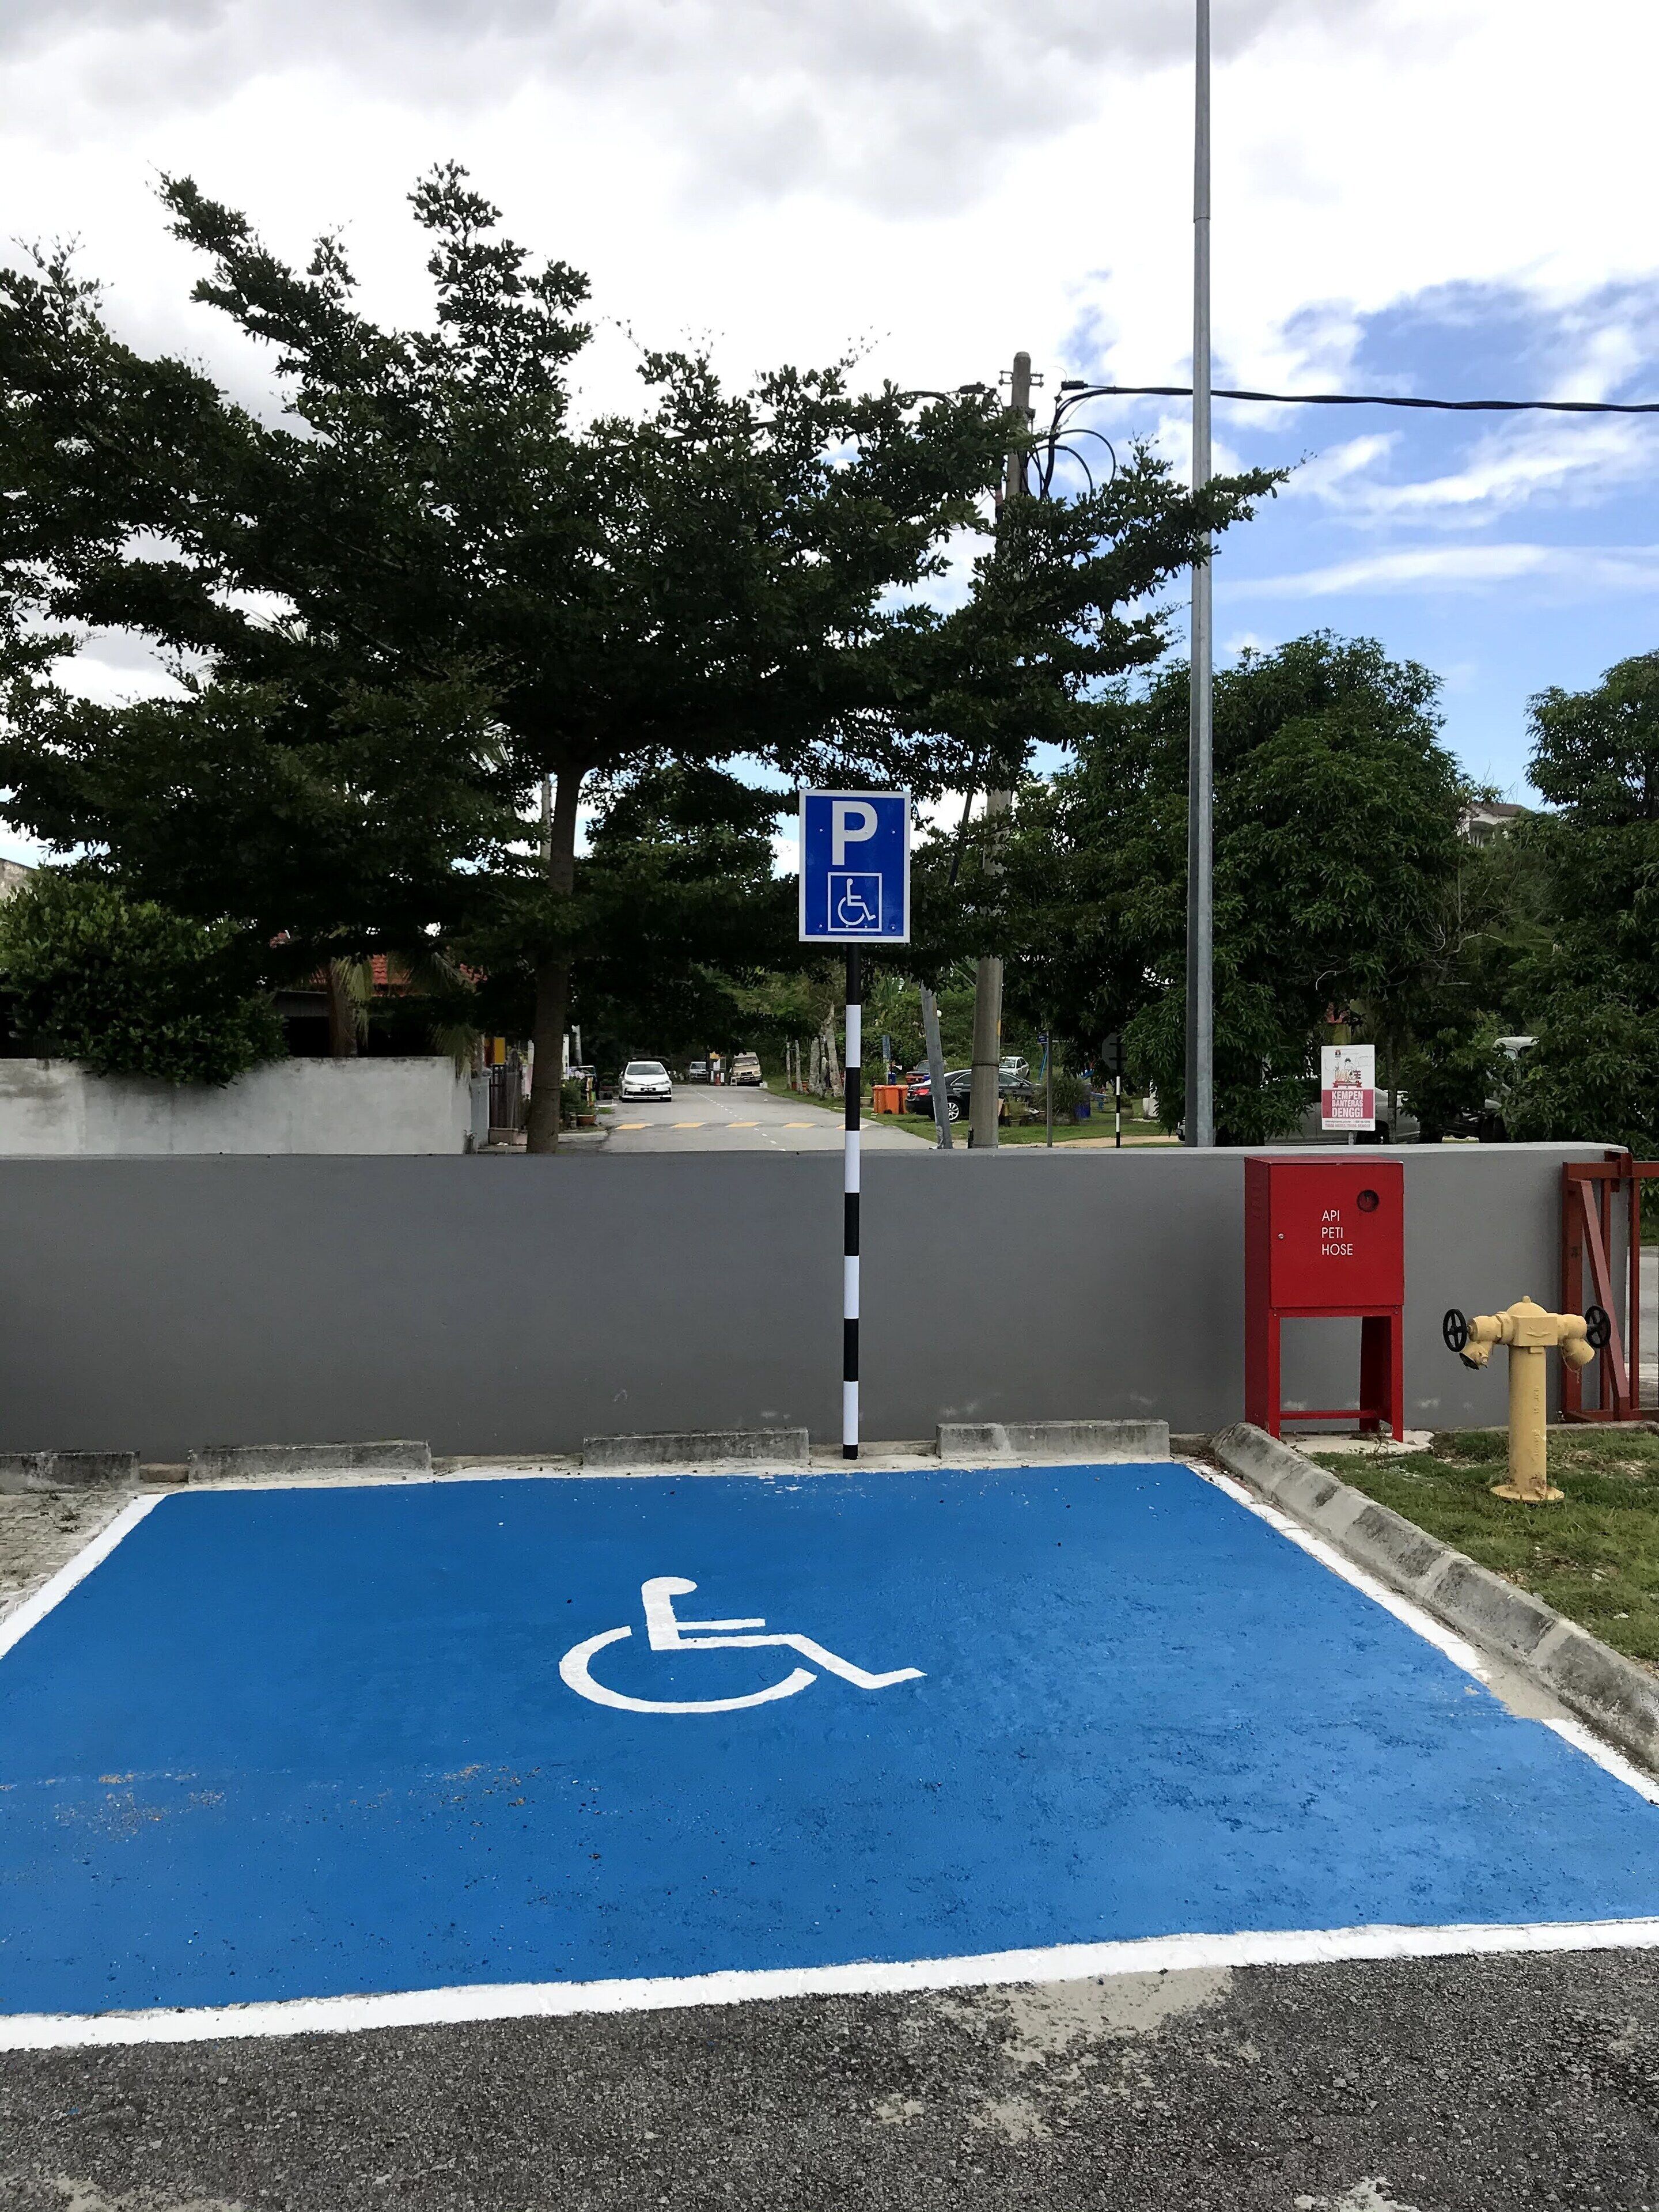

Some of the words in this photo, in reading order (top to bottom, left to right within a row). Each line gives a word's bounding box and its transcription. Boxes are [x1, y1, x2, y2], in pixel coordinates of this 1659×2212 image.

[832, 800, 878, 866] P
[1331, 1090, 1363, 1100] KEMPEN
[1331, 1107, 1363, 1118] DENGGI
[1321, 1210, 1340, 1222] API
[1321, 1227, 1343, 1238] PETI
[1321, 1243, 1353, 1256] HOSE
